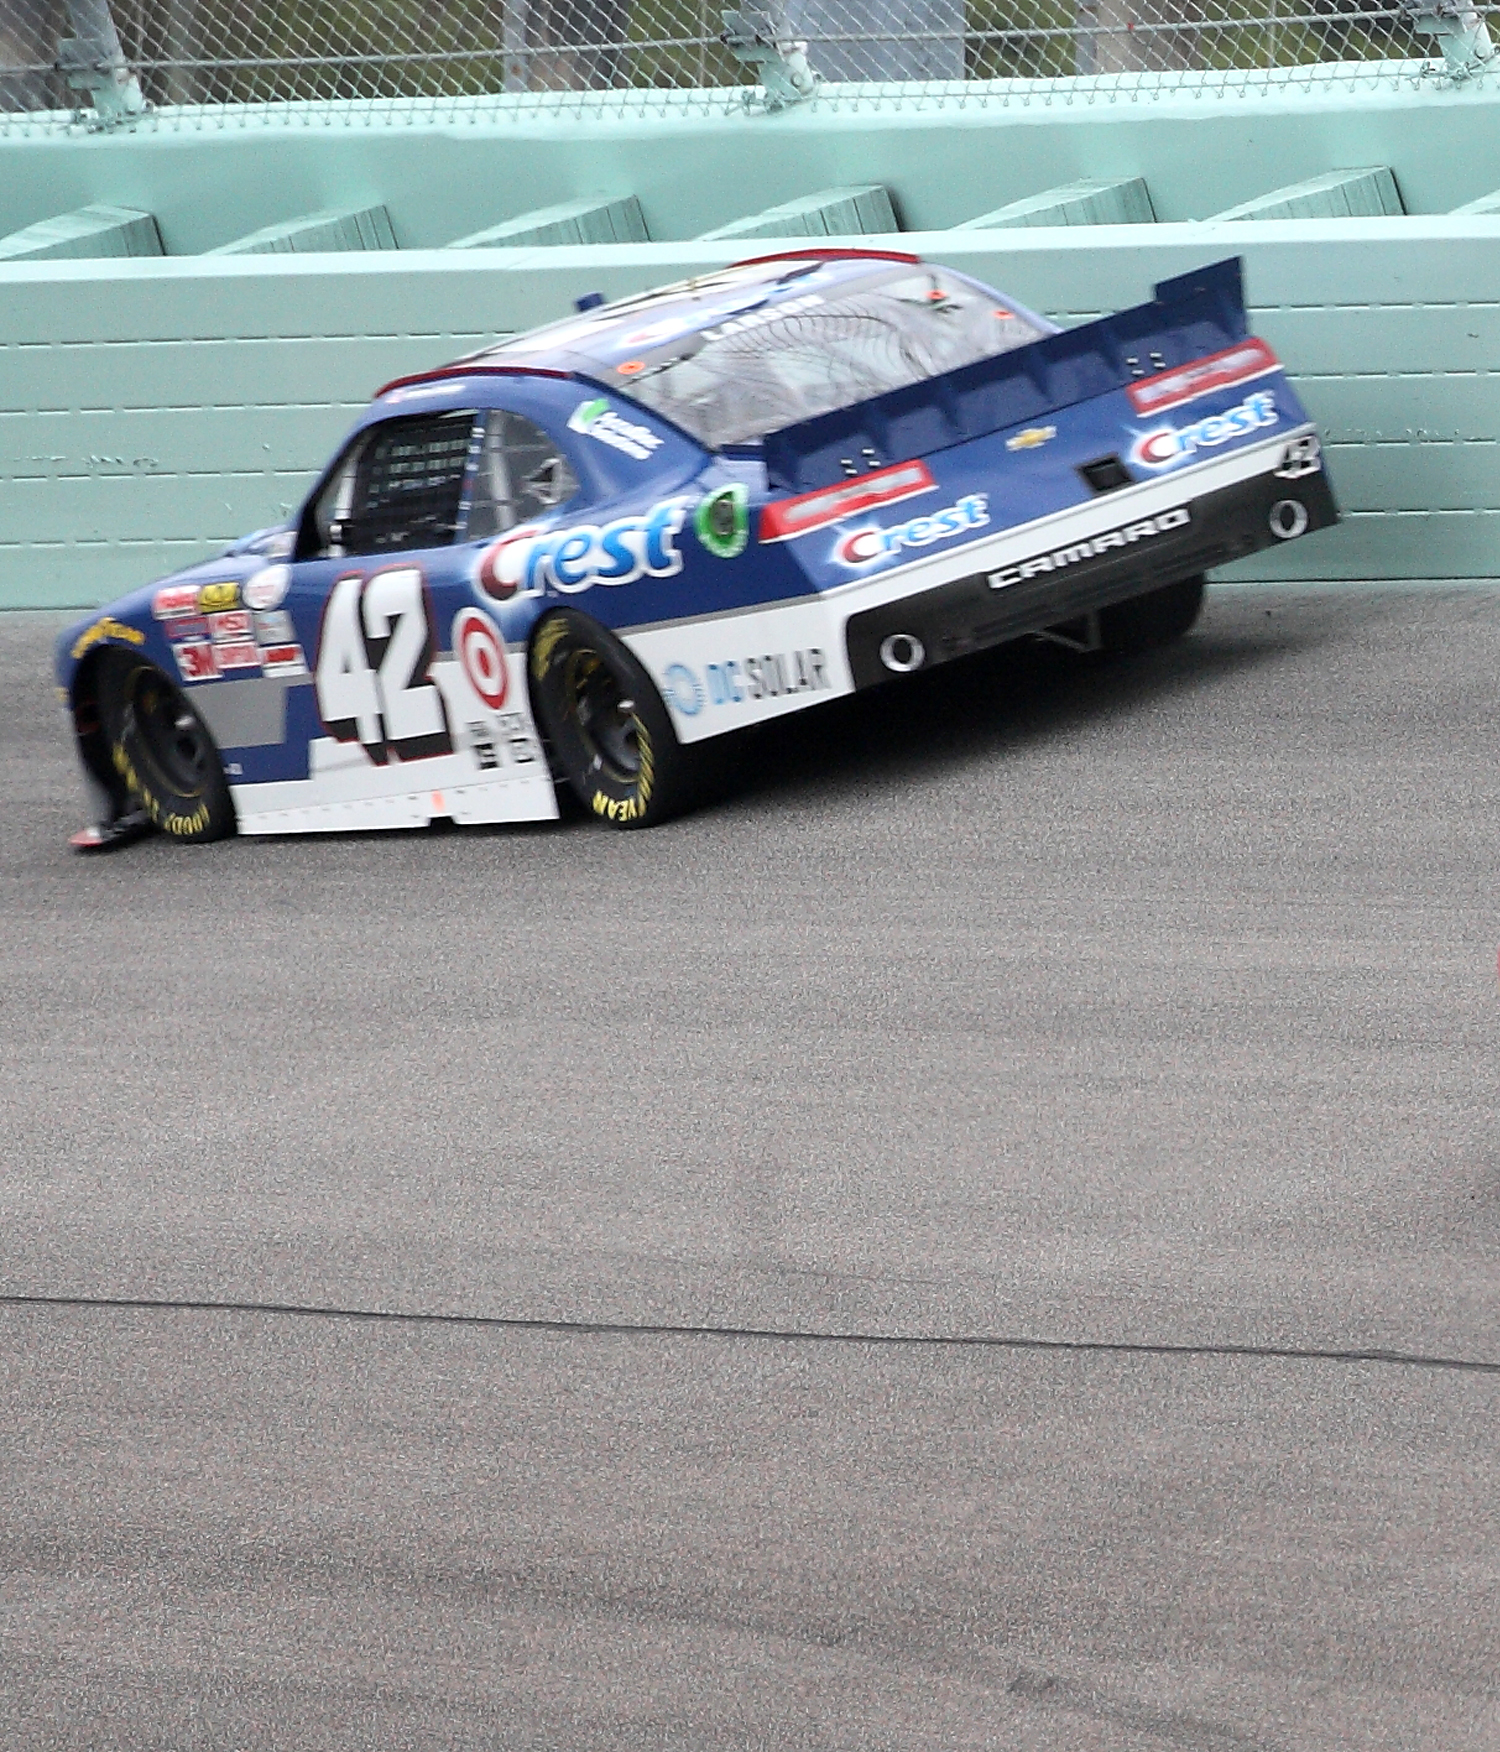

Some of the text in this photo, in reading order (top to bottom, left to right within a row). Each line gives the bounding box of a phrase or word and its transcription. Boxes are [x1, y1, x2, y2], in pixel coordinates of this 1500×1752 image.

[1136, 391, 1279, 466] Crest
[476, 500, 692, 603] Crest
[835, 494, 991, 566] Crest
[988, 506, 1191, 589] CAMARO
[314, 562, 456, 766] 42
